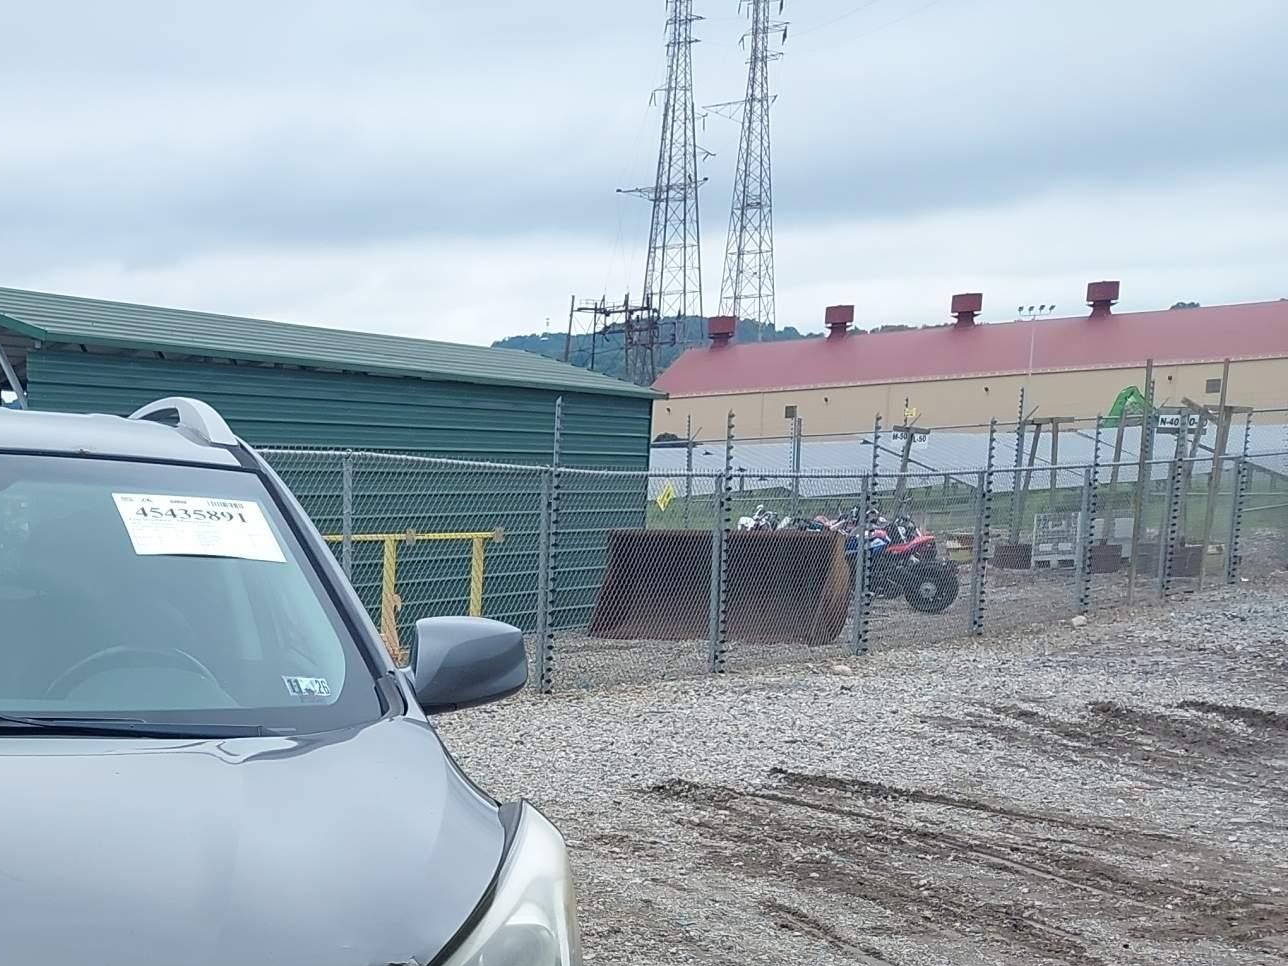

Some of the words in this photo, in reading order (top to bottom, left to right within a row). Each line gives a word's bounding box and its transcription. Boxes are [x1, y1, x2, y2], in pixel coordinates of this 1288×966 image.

[1159, 417, 1180, 426] N-40
[135, 506, 248, 523] 45435891
[315, 679, 330, 695] 26
